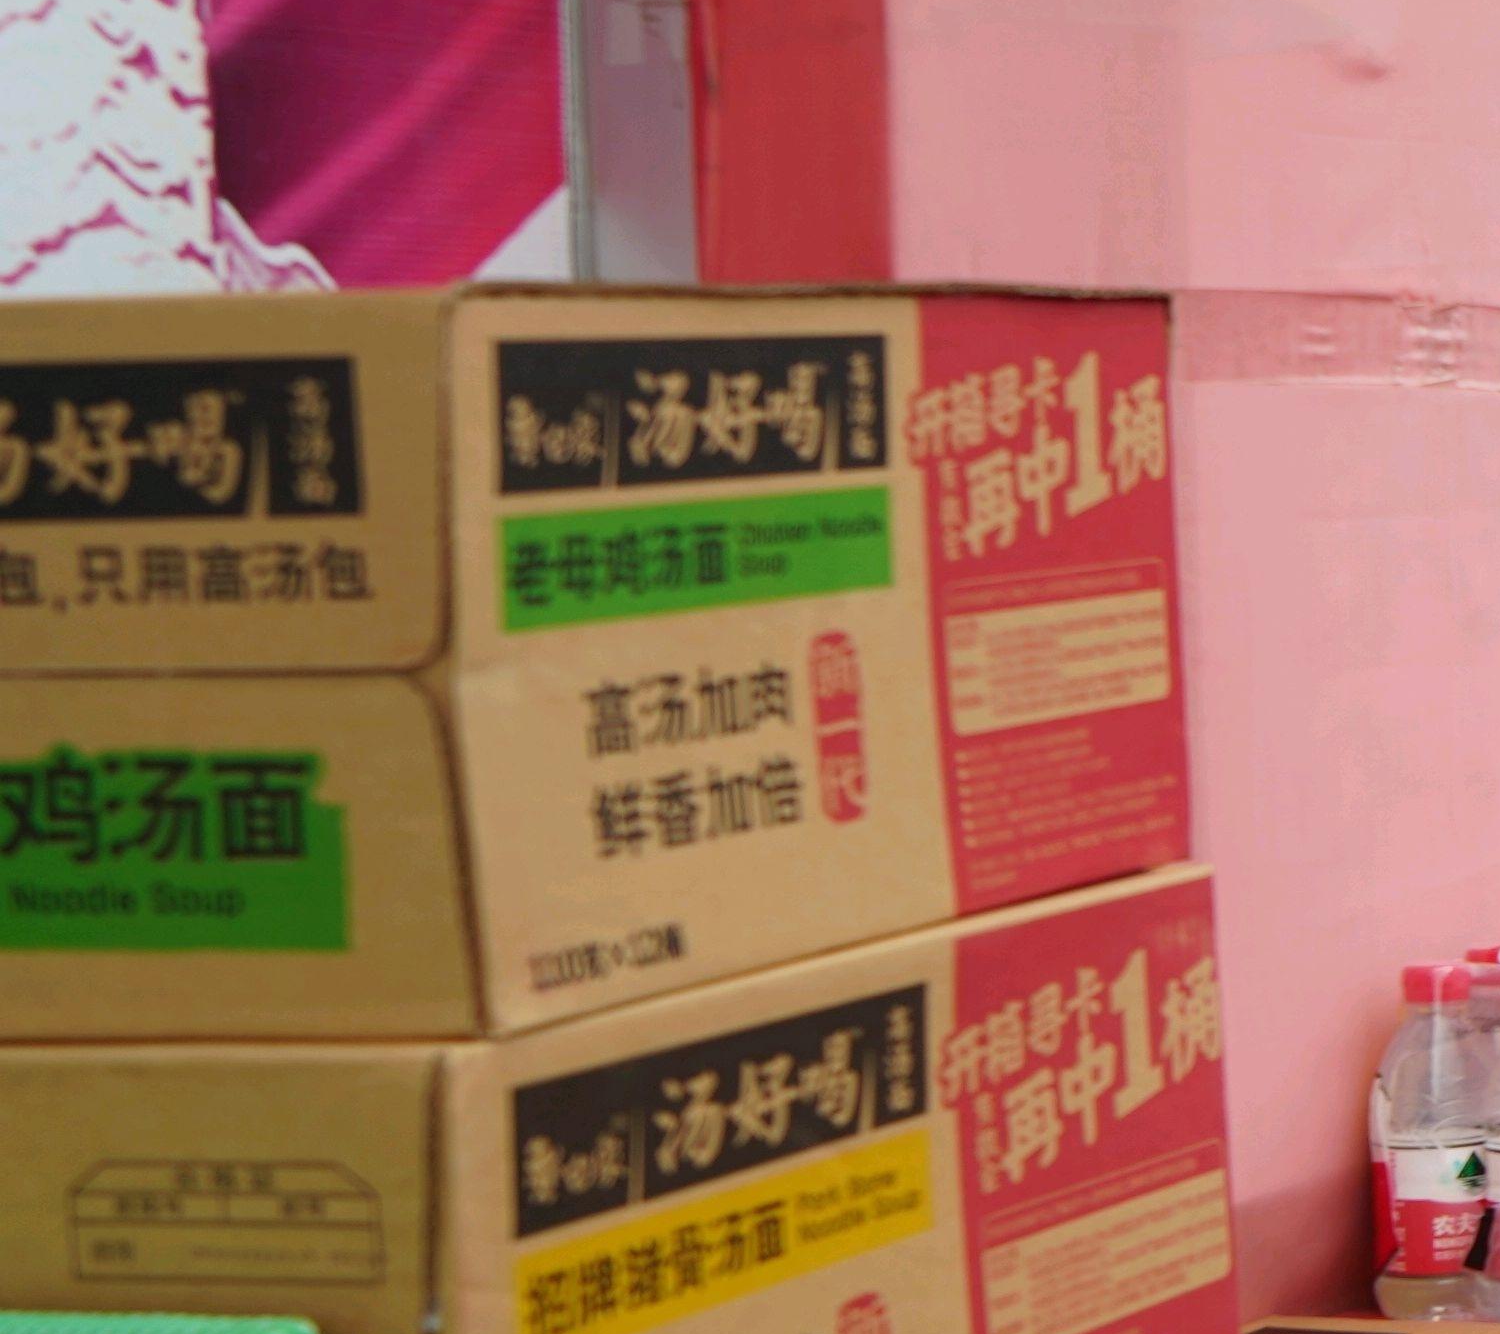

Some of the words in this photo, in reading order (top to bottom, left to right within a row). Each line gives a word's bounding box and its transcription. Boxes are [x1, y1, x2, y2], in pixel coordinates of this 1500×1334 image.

[626, 362, 827, 468] 汤好喝
[584, 660, 792, 757] 高汤加肉
[592, 761, 804, 857] 鲜香加倍
[652, 1032, 861, 1170] 汤好喝
